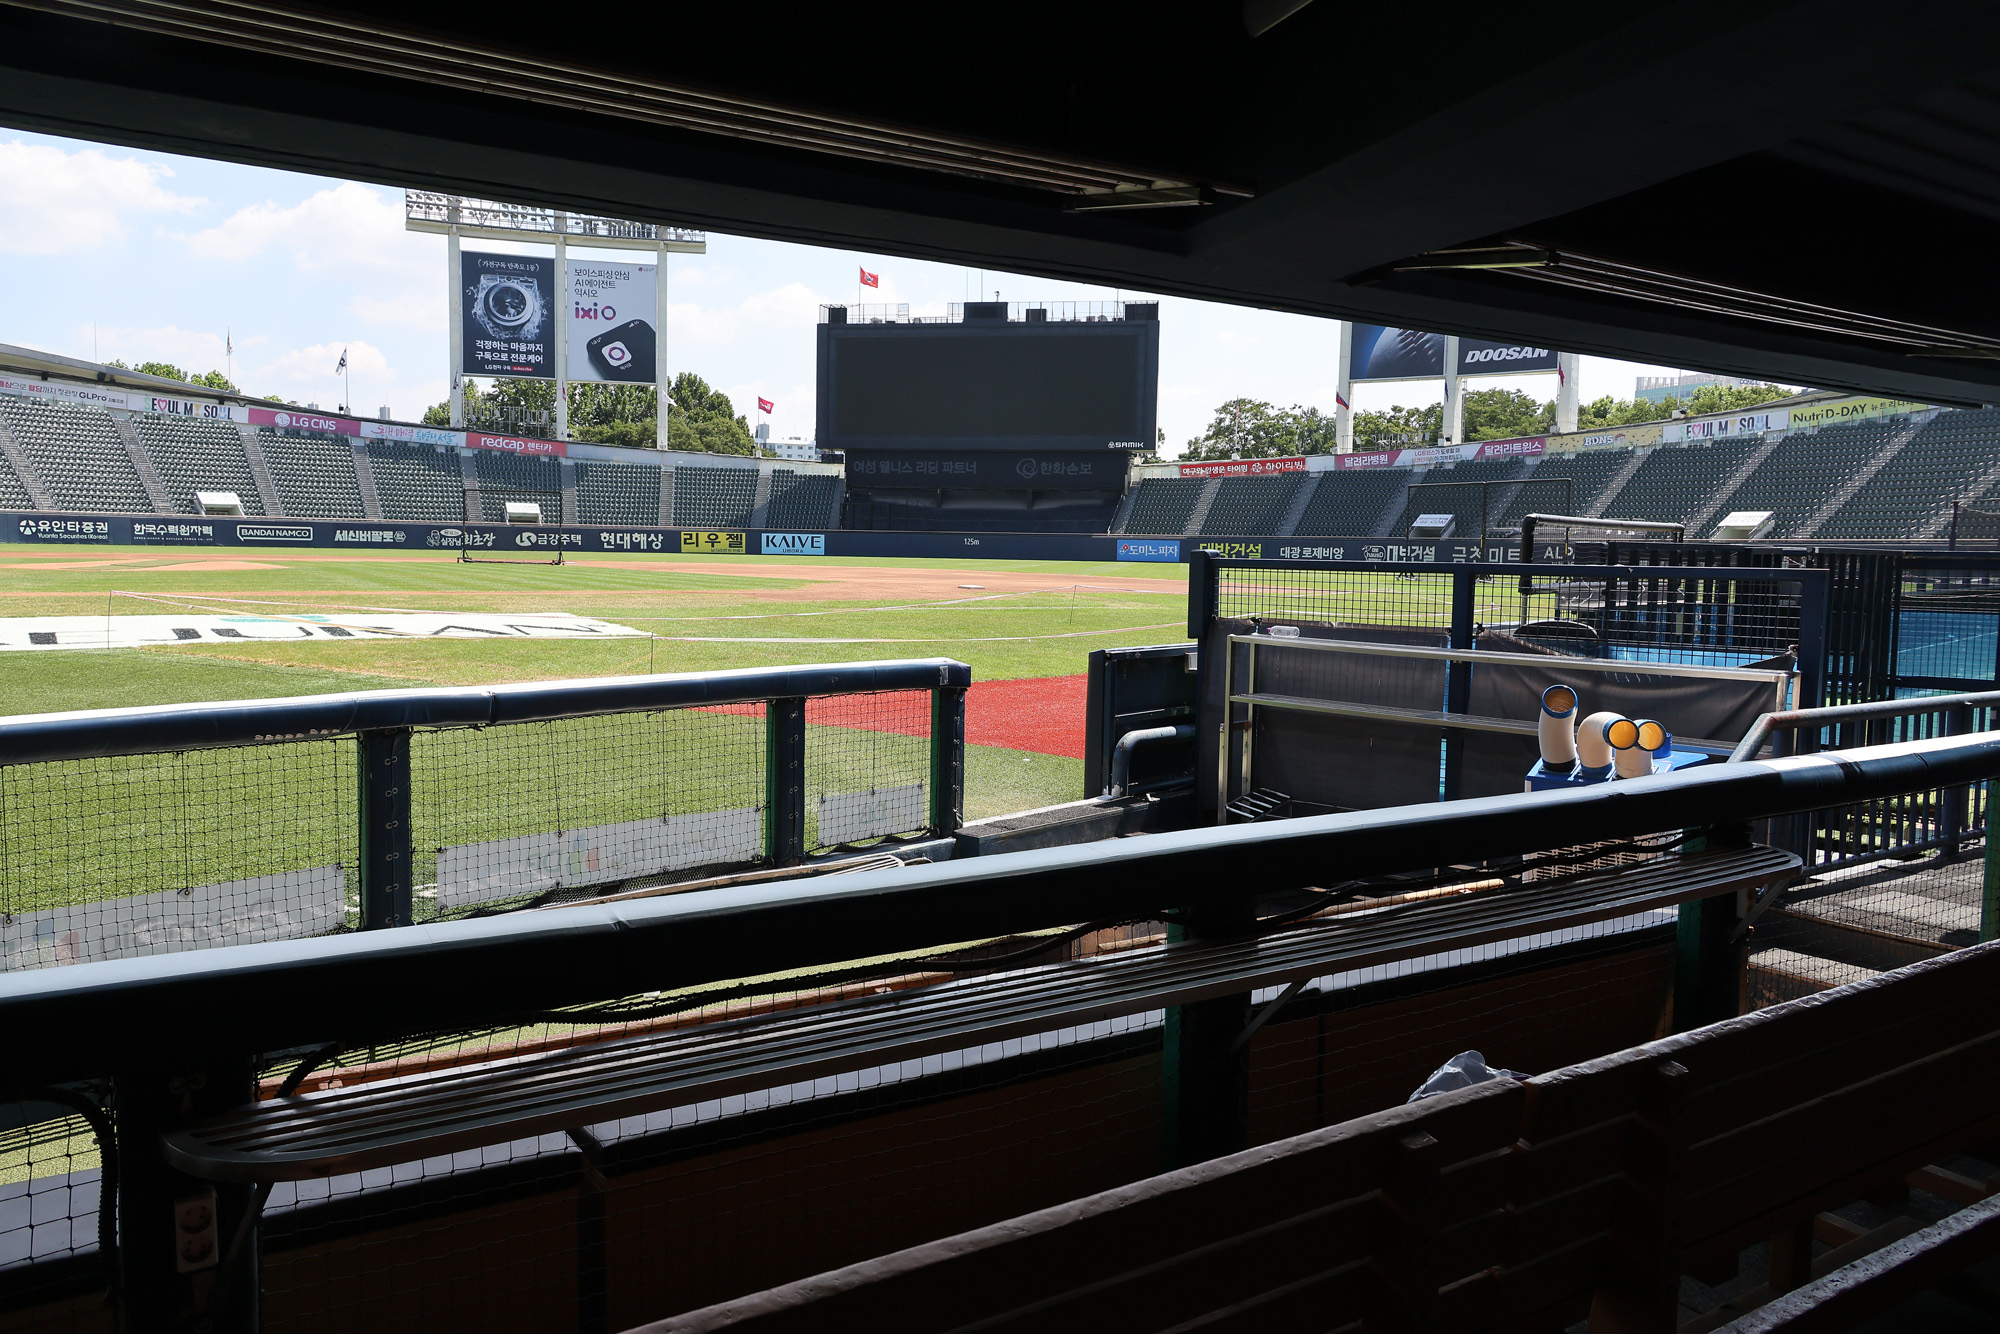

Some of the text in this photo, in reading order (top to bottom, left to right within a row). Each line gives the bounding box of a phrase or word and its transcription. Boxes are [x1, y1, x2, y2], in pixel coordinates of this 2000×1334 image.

[574, 268, 630, 281] 보이스피싱 안심
[574, 279, 616, 289] AI 에이전트
[574, 288, 598, 298] 익시오
[475, 339, 544, 353] 걱정하는 마음까지
[475, 351, 509, 362] 구독으로
[1465, 346, 1548, 363] DOOSAN
[79, 391, 107, 402] GLPro
[292, 415, 336, 430] LG CNS
[481, 435, 553, 453] redcap 렌터카
[1583, 434, 1614, 447] BDNS
[1484, 441, 1542, 456] 달려라트윈스
[853, 460, 1093, 475] 여성 웰니스 리딩 파트너 한화손보
[1344, 454, 1389, 468] 달려라병원
[37, 520, 109, 534] 유안타증권
[134, 522, 213, 536] 한국수력원자력
[241, 528, 309, 537] BANDAI NAMCO
[334, 529, 394, 543] 세신버팔로
[441, 537, 462, 546] 실장님
[537, 533, 582, 546] 금강주택
[600, 531, 664, 550] 현대해상
[765, 535, 822, 549] KAIVE
[963, 537, 980, 546] 125m
[1128, 544, 1179, 557] 도미노피자
[1280, 547, 1344, 560] 대광 로제비앙
